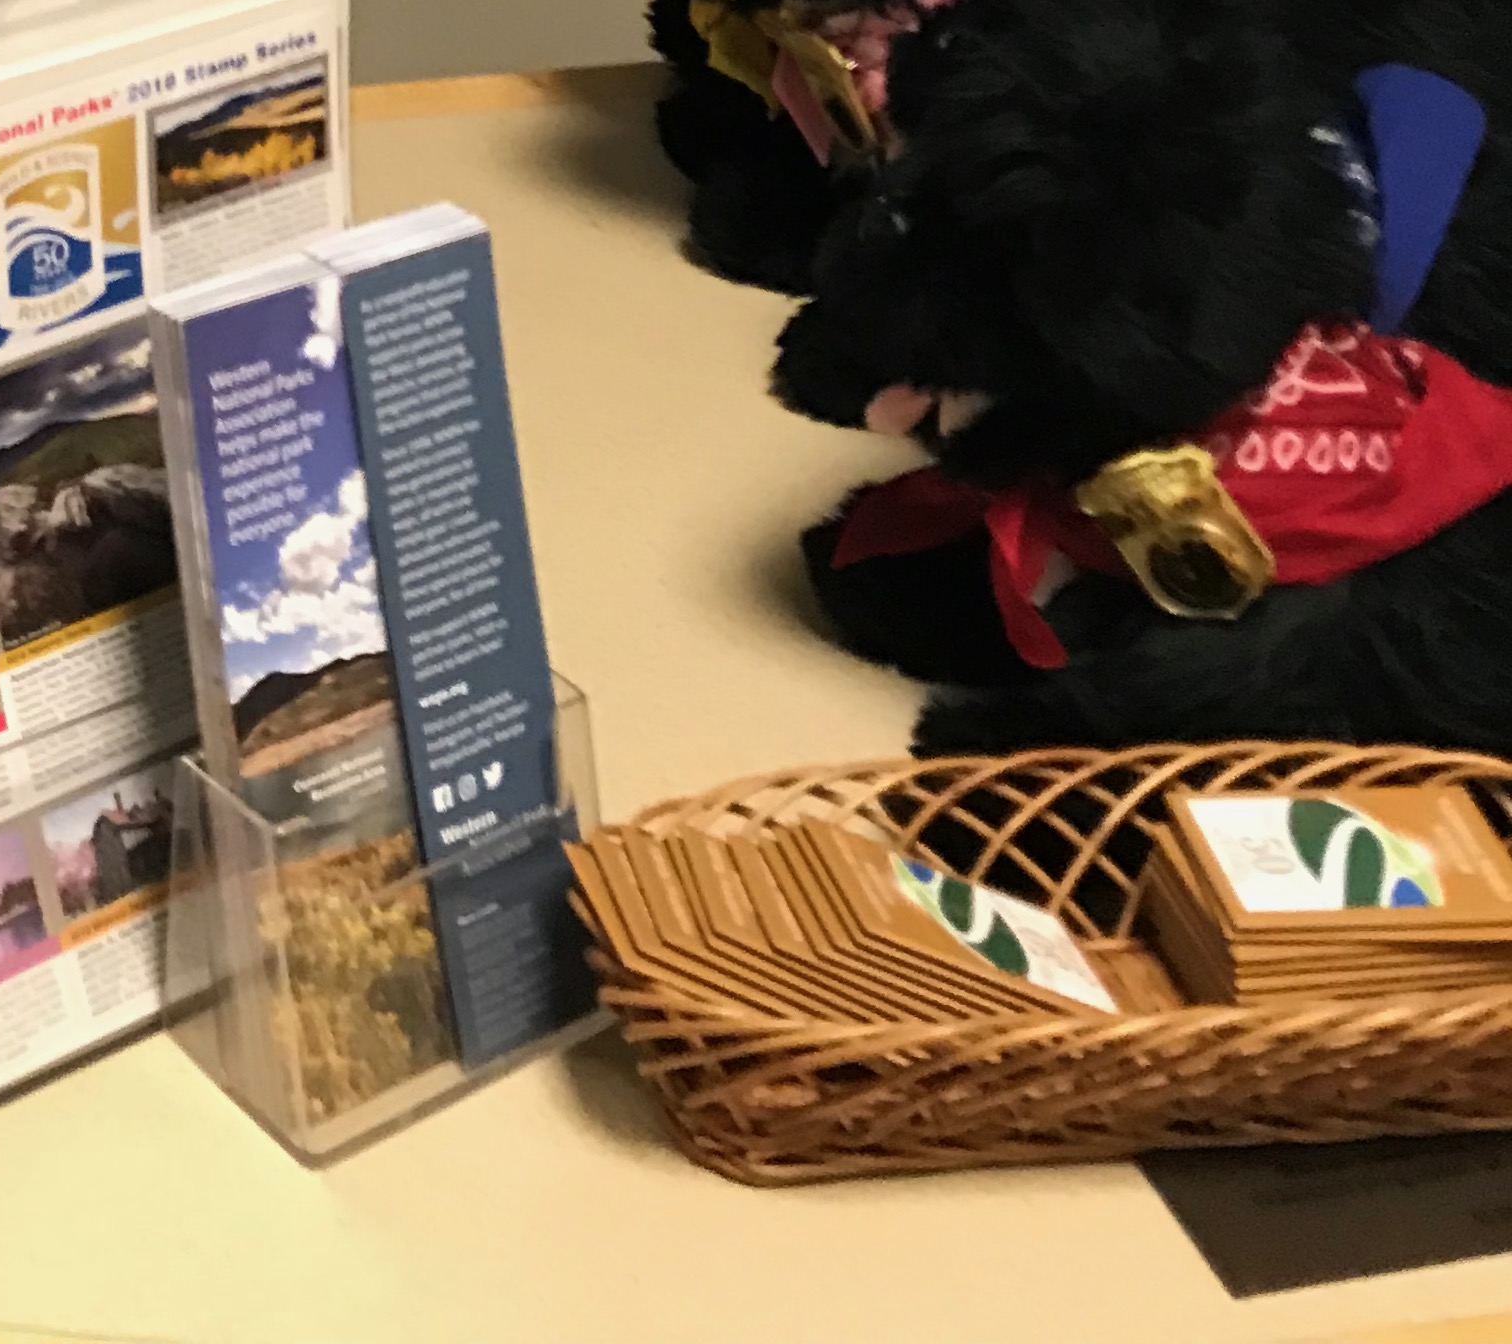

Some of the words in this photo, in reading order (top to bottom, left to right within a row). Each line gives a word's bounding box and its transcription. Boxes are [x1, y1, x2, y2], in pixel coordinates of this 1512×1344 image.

[125, 76, 177, 106] 2018
[182, 53, 249, 84] Stamp
[254, 29, 318, 64] Series
[31, 237, 72, 275] 50
